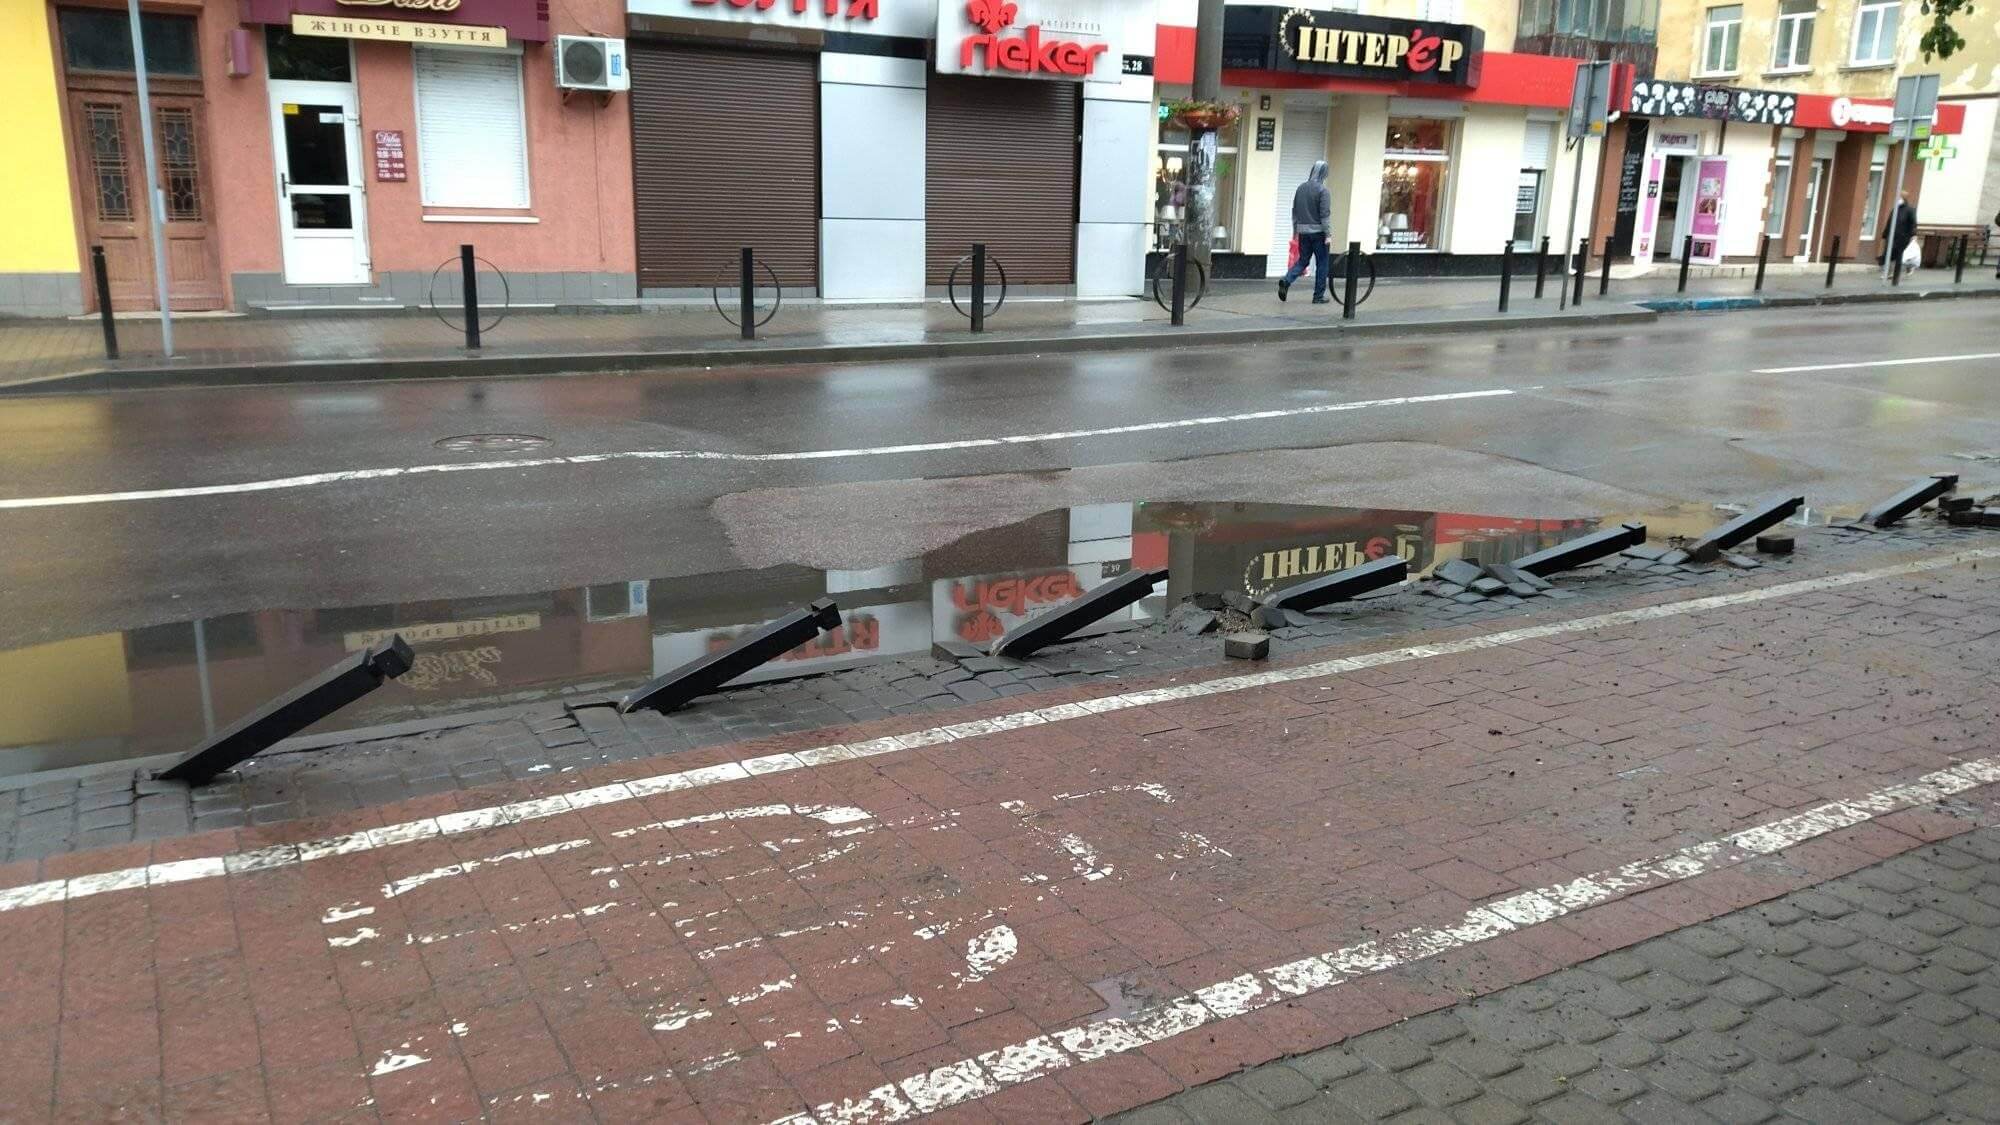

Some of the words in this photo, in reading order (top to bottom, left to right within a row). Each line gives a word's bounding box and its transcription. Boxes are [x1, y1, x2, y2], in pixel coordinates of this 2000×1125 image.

[310, 20, 401, 36] ЖІНОЧЕ
[414, 28, 491, 42] ВЗУТТЯ
[960, 24, 1108, 75] rieker
